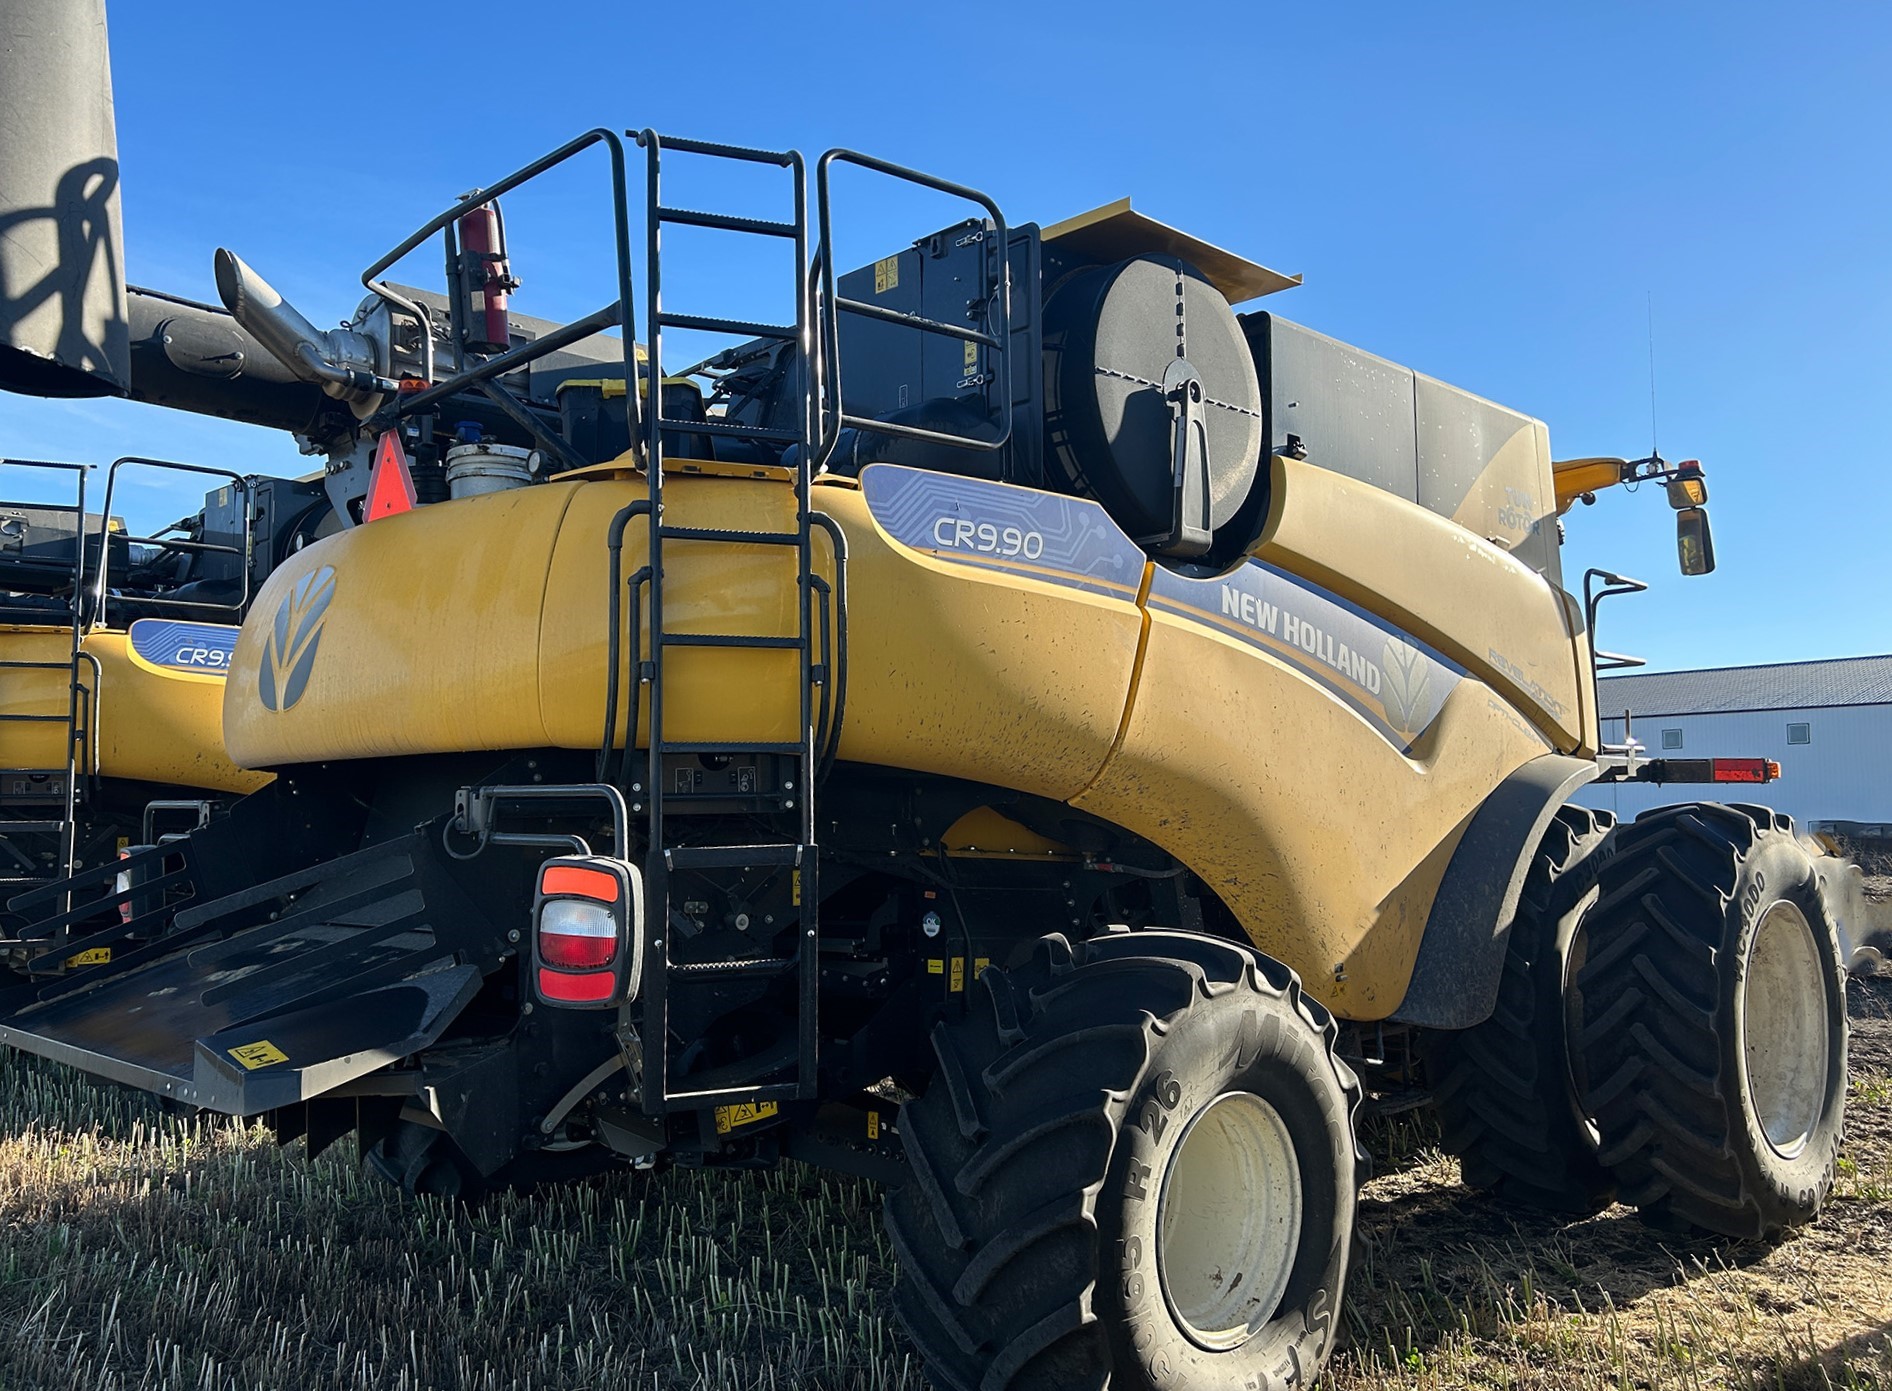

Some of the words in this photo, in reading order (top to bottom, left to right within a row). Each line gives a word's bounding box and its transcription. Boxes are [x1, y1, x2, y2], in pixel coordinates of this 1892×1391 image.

[933, 517, 1044, 560] CR9.90
[1221, 584, 1279, 635] NEW
[1283, 611, 1382, 695] HOLLAND
[1734, 871, 1765, 983] HC3000
[1123, 1156, 1153, 1201] R
[1140, 1069, 1182, 1148] 26
